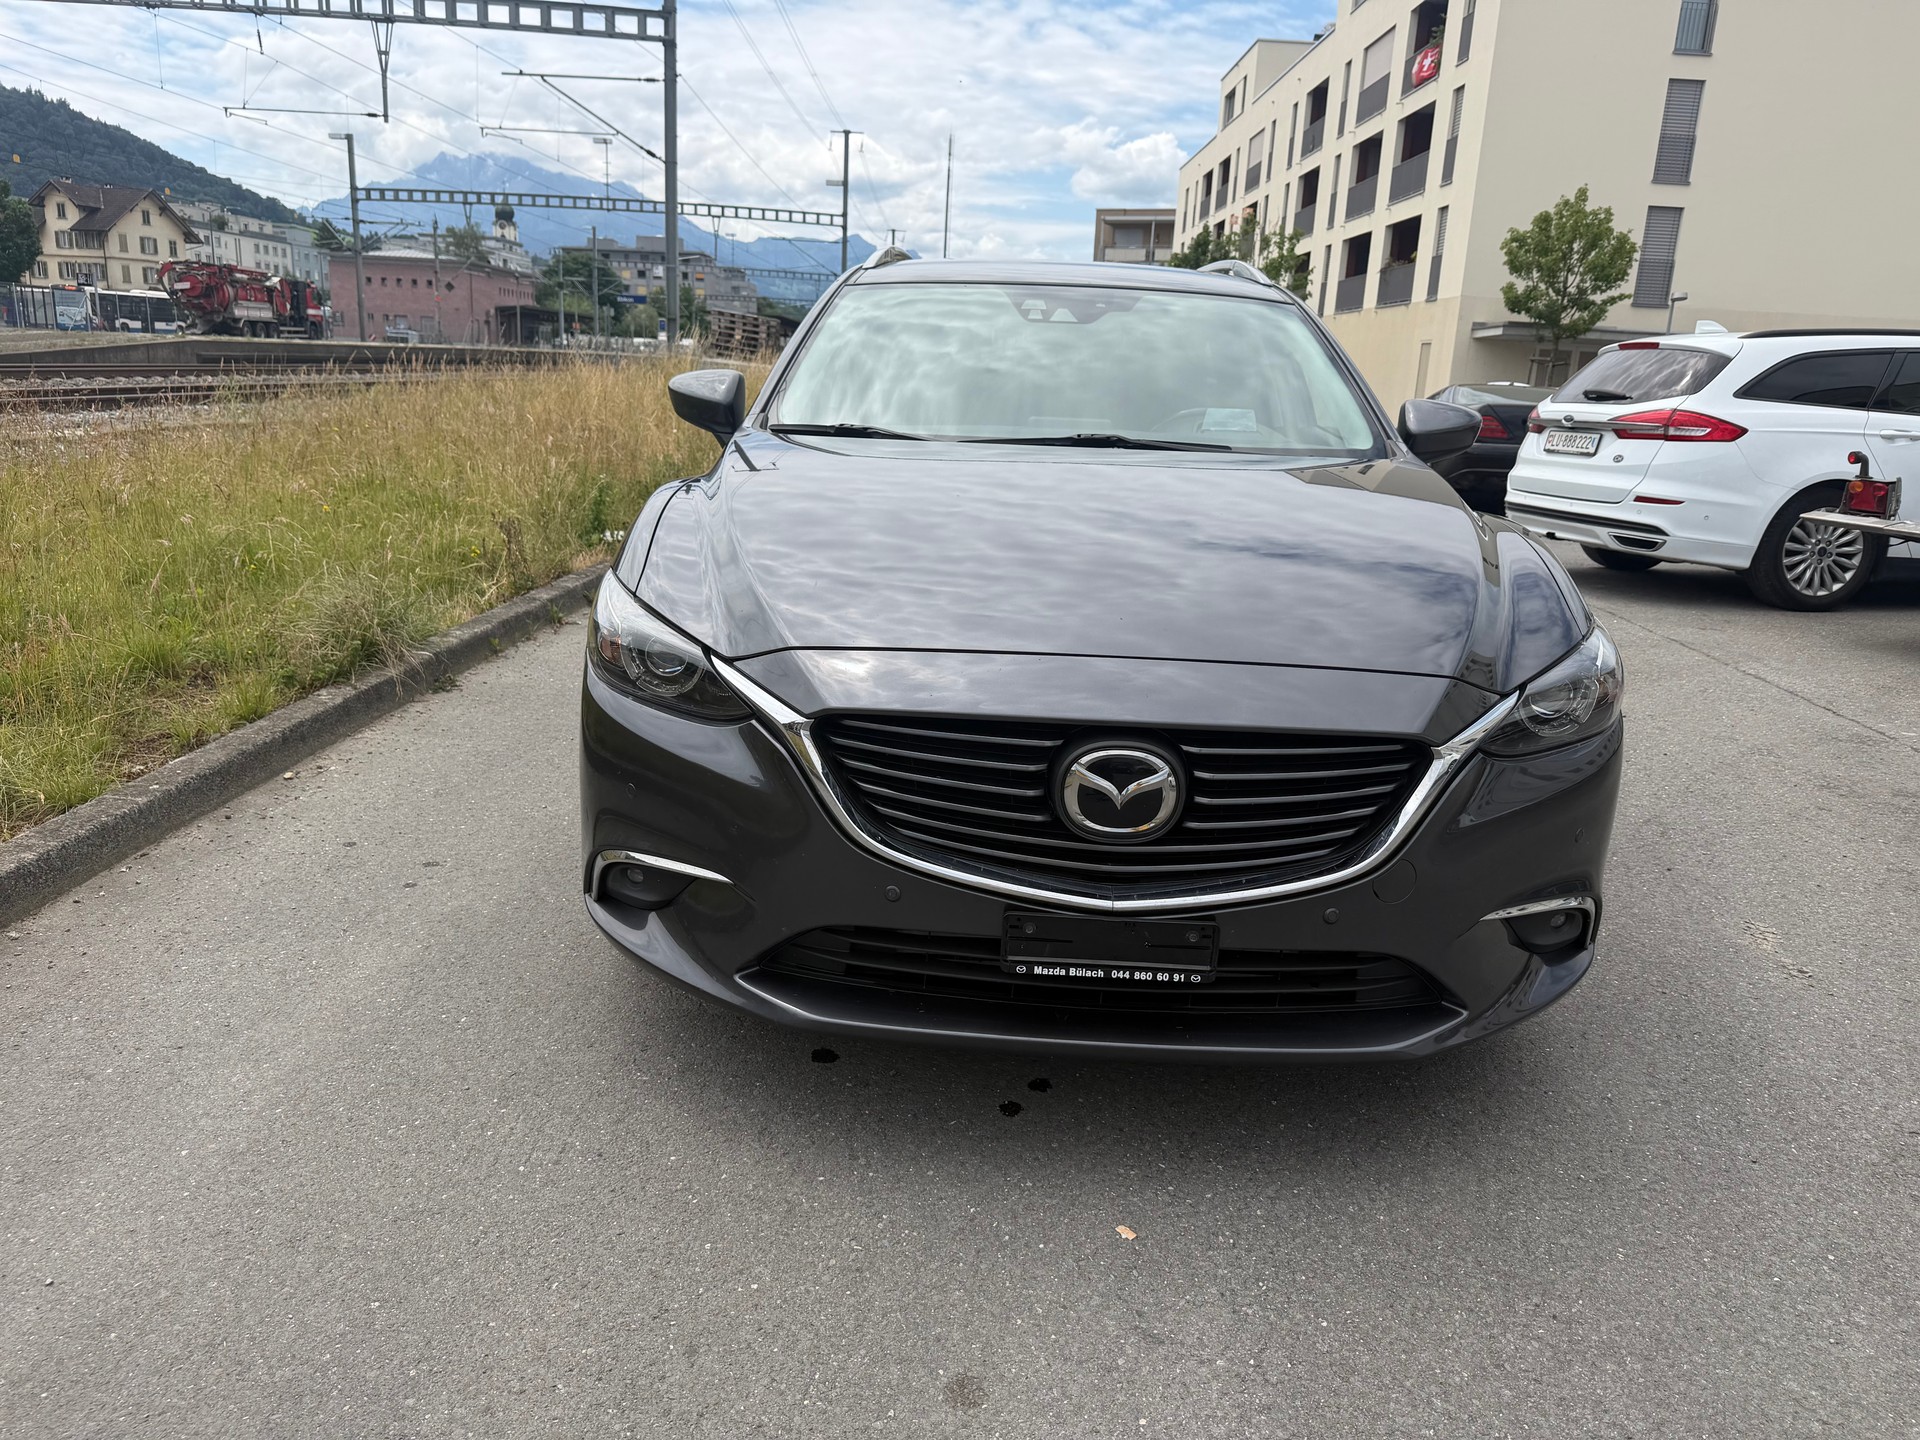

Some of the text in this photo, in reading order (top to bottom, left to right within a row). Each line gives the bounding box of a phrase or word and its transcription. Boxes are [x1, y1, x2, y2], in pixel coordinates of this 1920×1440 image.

[1033, 965, 1185, 982] Mazda Bülach 044 860 60 91
